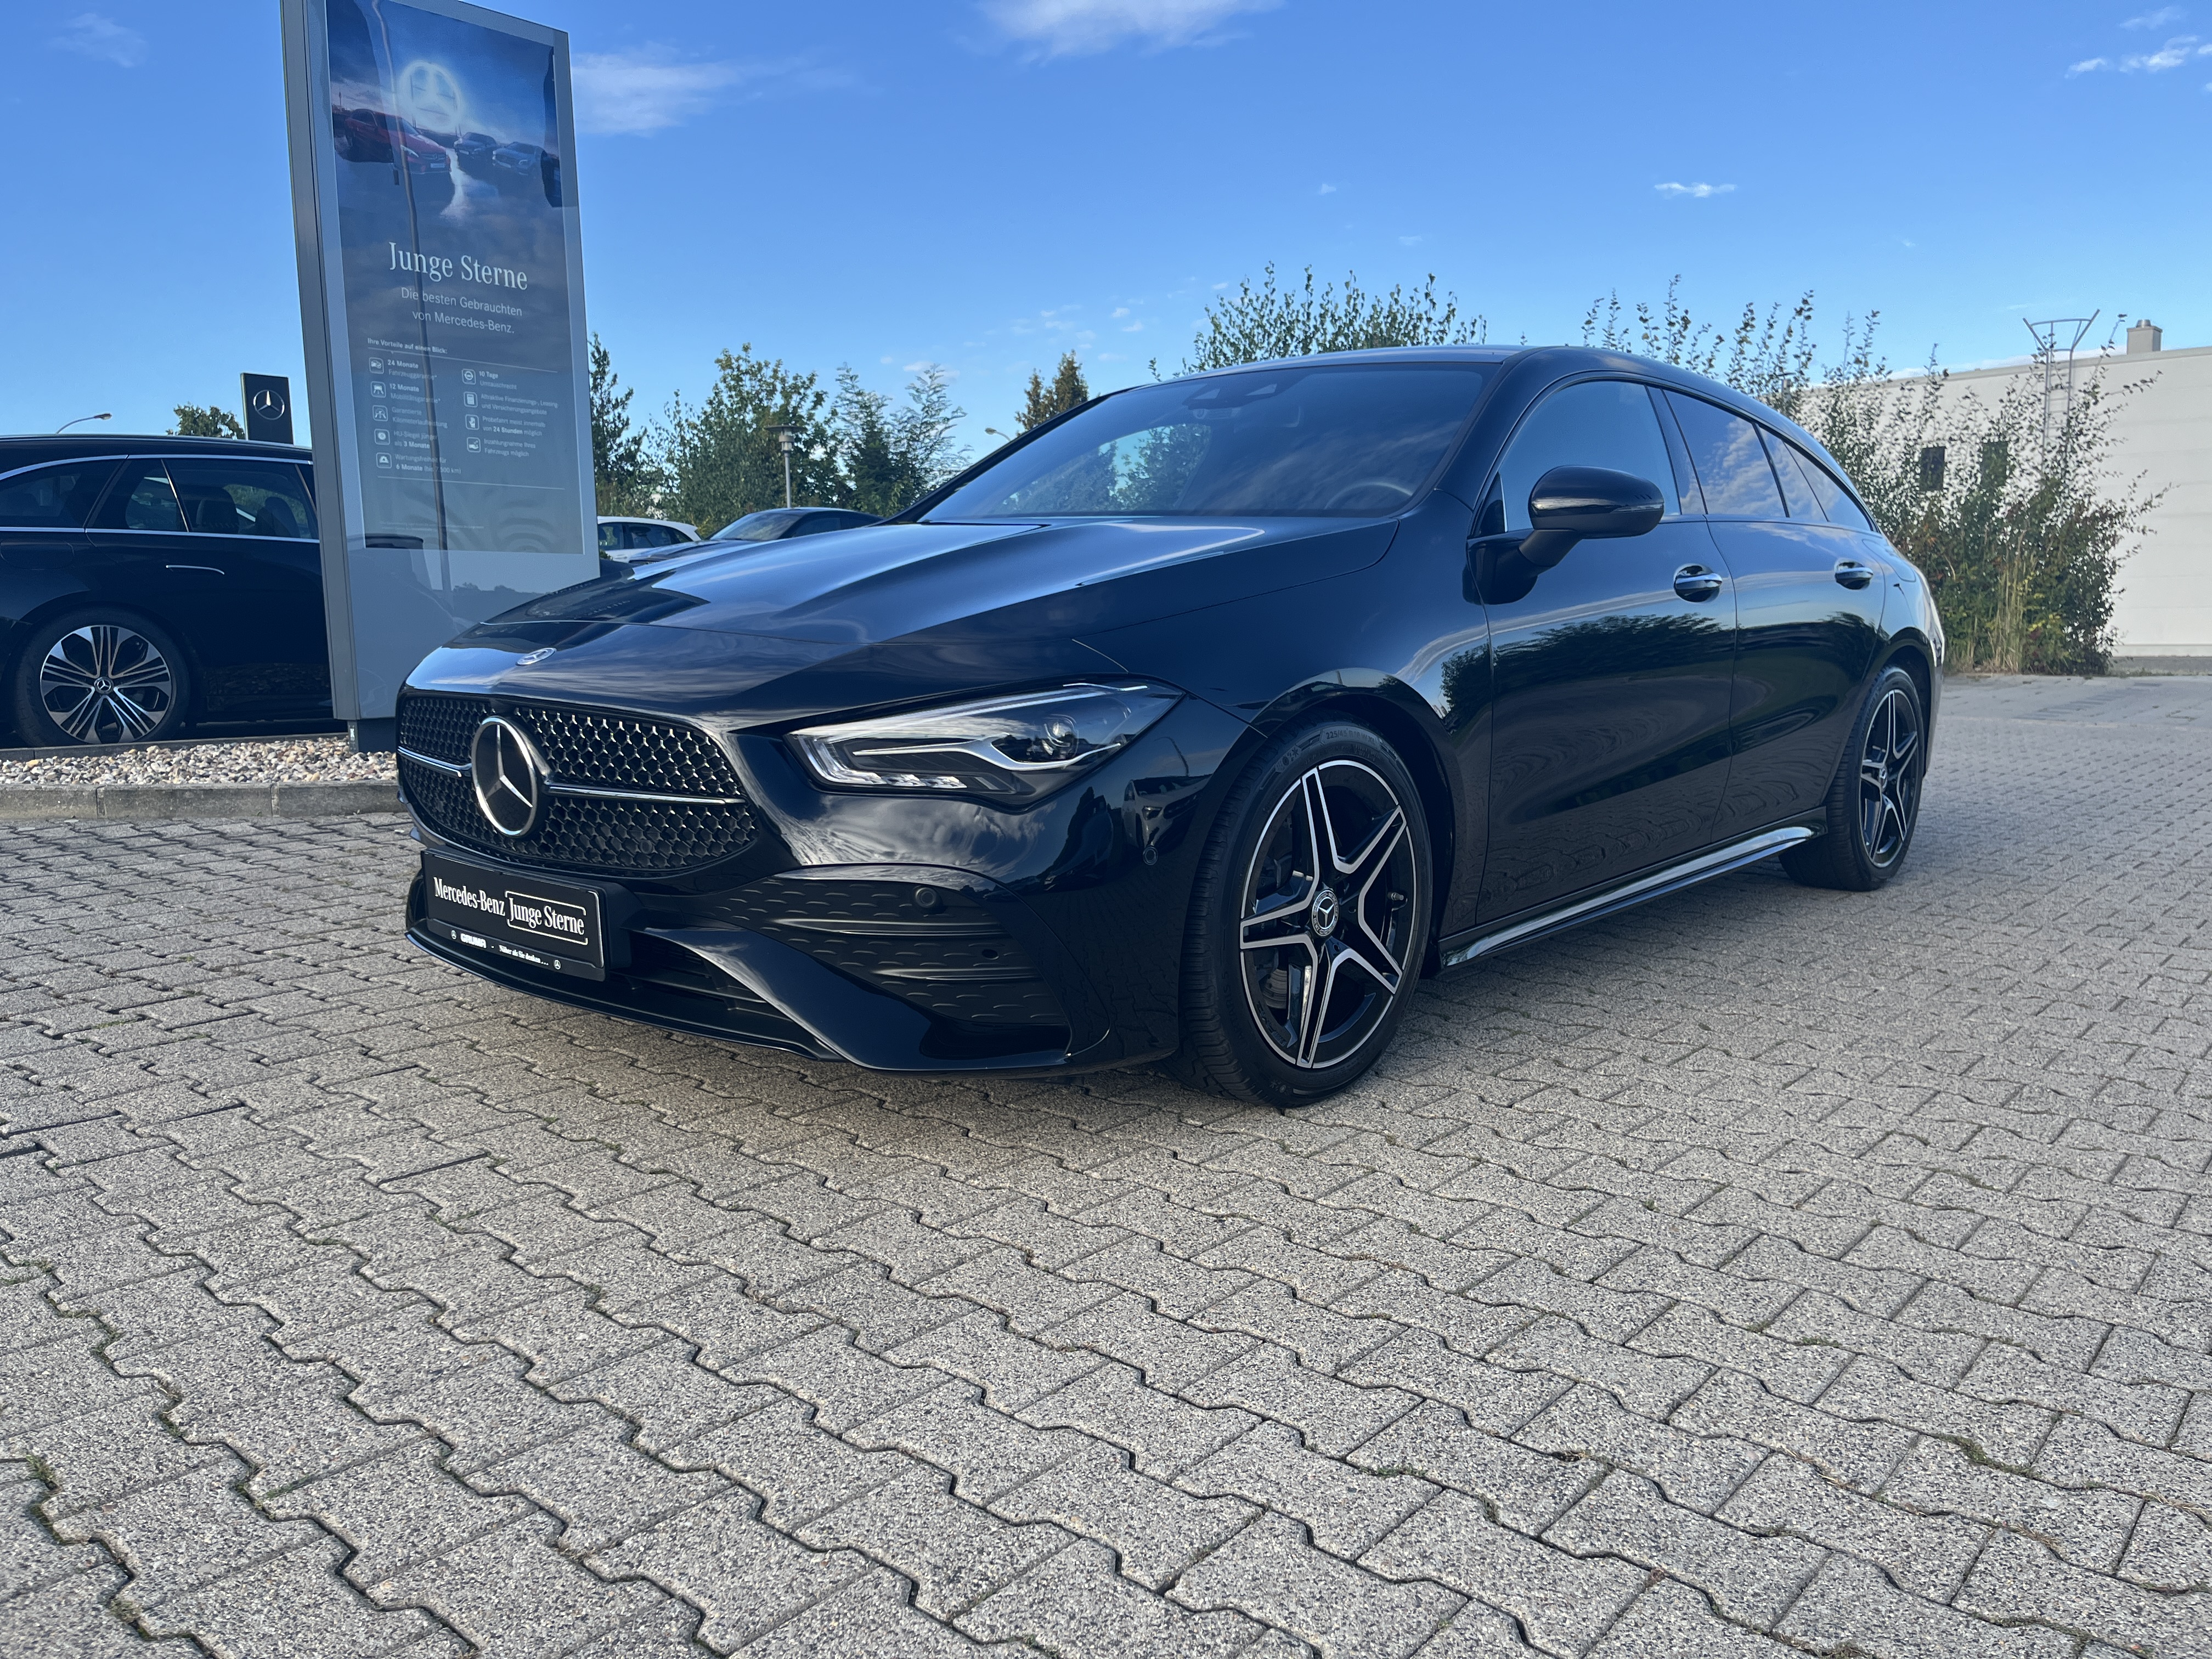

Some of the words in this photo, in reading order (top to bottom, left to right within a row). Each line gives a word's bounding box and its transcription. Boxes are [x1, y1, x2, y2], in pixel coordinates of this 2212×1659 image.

[388, 241, 453, 283] Junge
[461, 255, 528, 290] Sterne
[401, 287, 419, 300] Die
[422, 290, 456, 306] besten
[460, 296, 522, 316] Gebrauchten
[412, 311, 431, 321] von
[435, 311, 515, 334] Mercedes-Benz.
[380, 339, 403, 348] Vorteile
[396, 360, 419, 369] Monate
[486, 371, 499, 379] Tage
[398, 383, 420, 392] Monate
[401, 464, 423, 472] Monate
[433, 877, 506, 917] Mercedes-Benz
[509, 897, 543, 929] Junge
[544, 905, 585, 935] Sterne
